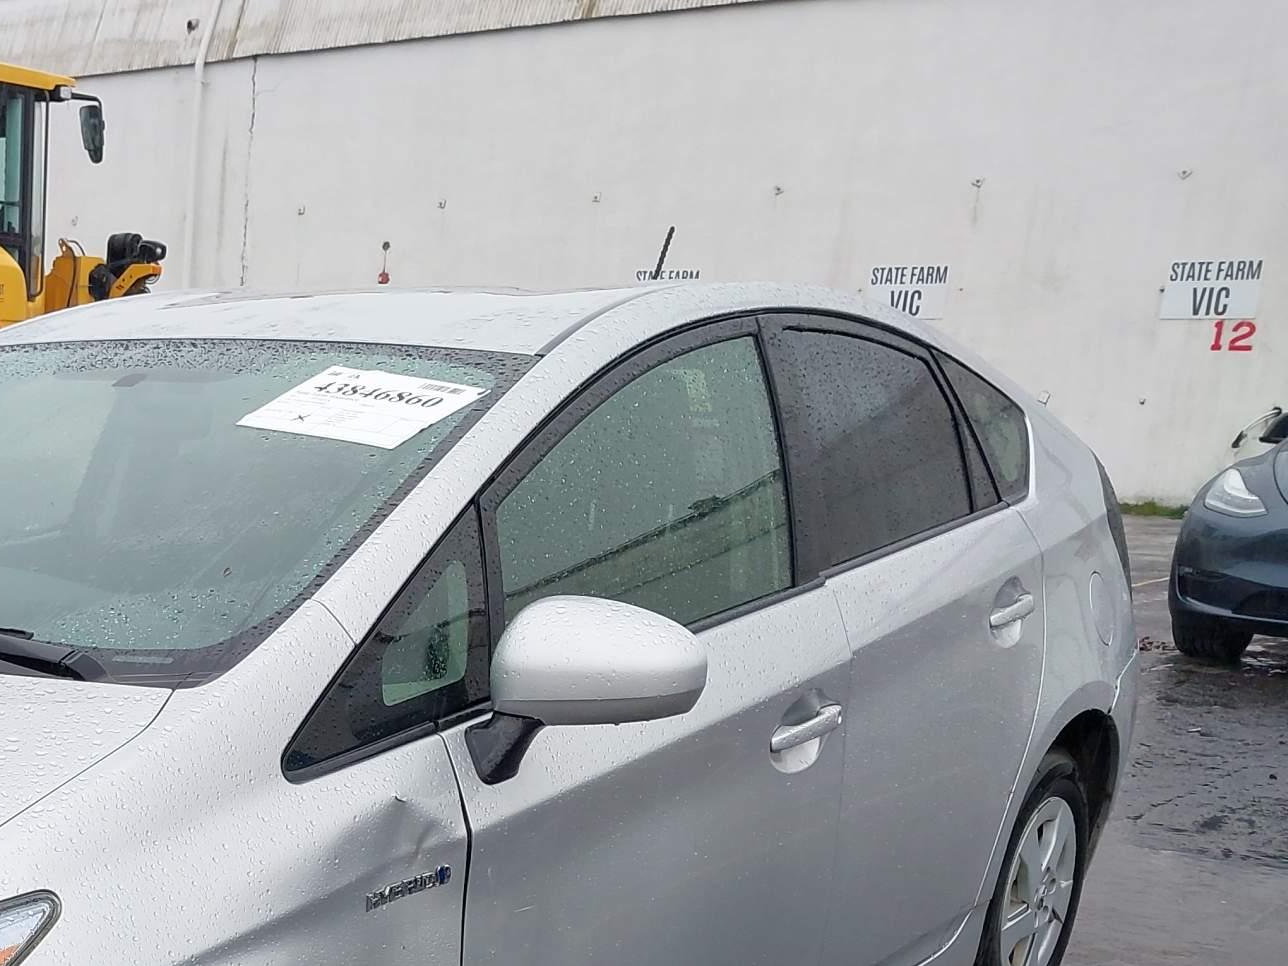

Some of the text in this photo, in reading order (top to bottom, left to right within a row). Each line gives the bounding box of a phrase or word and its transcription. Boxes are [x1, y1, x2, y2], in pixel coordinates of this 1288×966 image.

[636, 270, 666, 281] STAE
[871, 265, 948, 285] STATE FARM
[1170, 259, 1264, 282] STATE FARM
[890, 290, 922, 317] VIC
[1192, 286, 1231, 317] VIC
[1210, 319, 1257, 352] 12
[314, 381, 444, 408] 43846860
